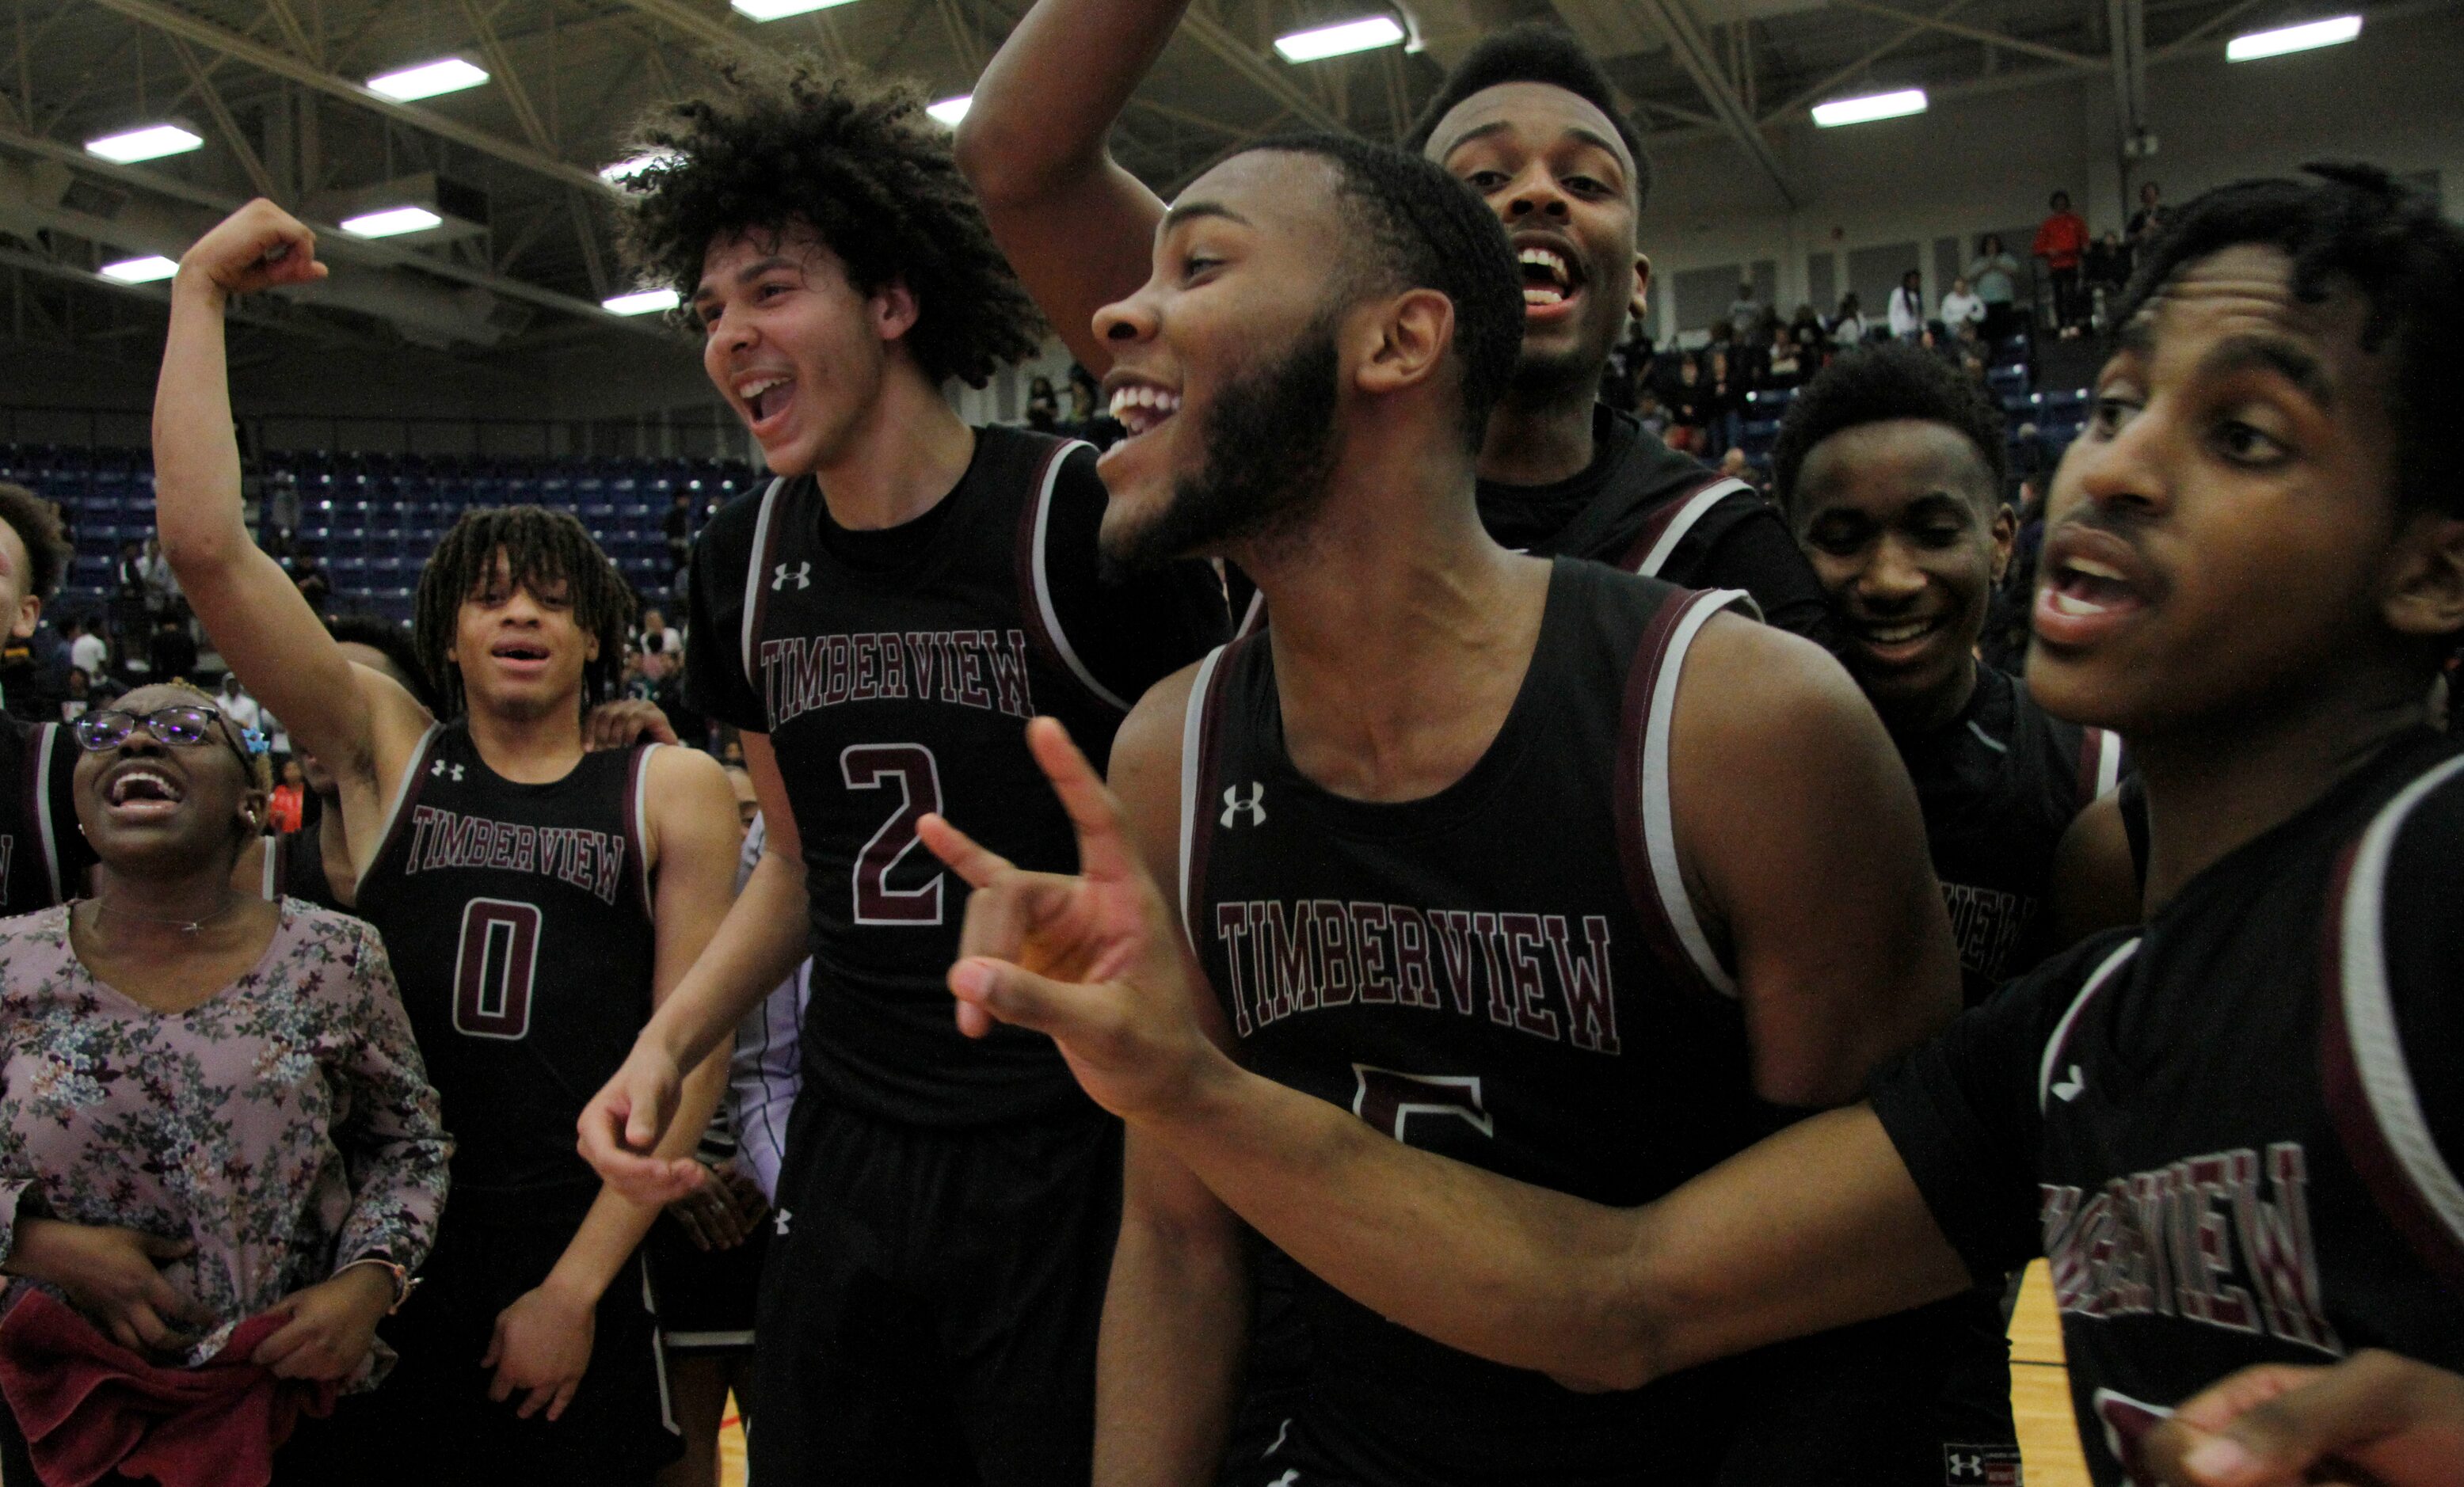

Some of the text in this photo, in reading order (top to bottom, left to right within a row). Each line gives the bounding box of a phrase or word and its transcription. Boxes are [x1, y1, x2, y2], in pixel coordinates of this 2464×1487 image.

[761, 629, 1036, 733] TIMBERVIEW
[406, 804, 624, 906] TIMBERVIEW
[840, 743, 944, 926] 2
[452, 896, 543, 1040] 0
[1217, 899, 1620, 1056] TIMBERVIEW
[1939, 880, 2039, 986] IEW
